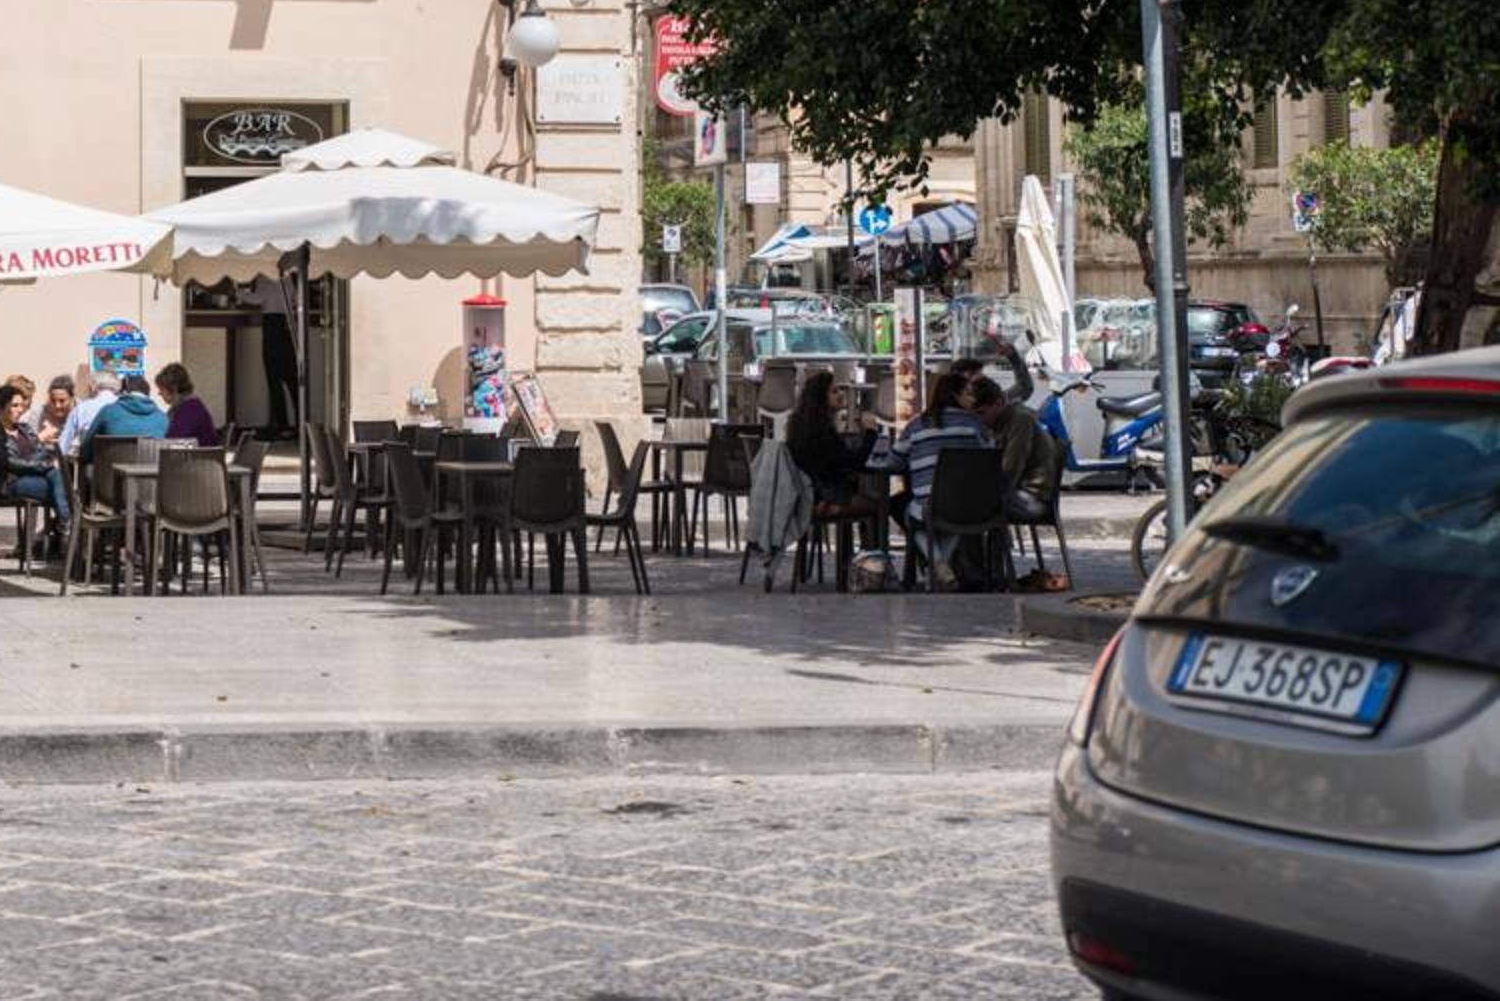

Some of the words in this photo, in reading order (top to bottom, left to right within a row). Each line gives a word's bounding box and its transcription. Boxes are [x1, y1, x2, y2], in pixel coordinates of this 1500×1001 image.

[230, 112, 296, 136] BAR
[31, 242, 143, 270] MORETTI
[1191, 640, 1243, 689] EJ
